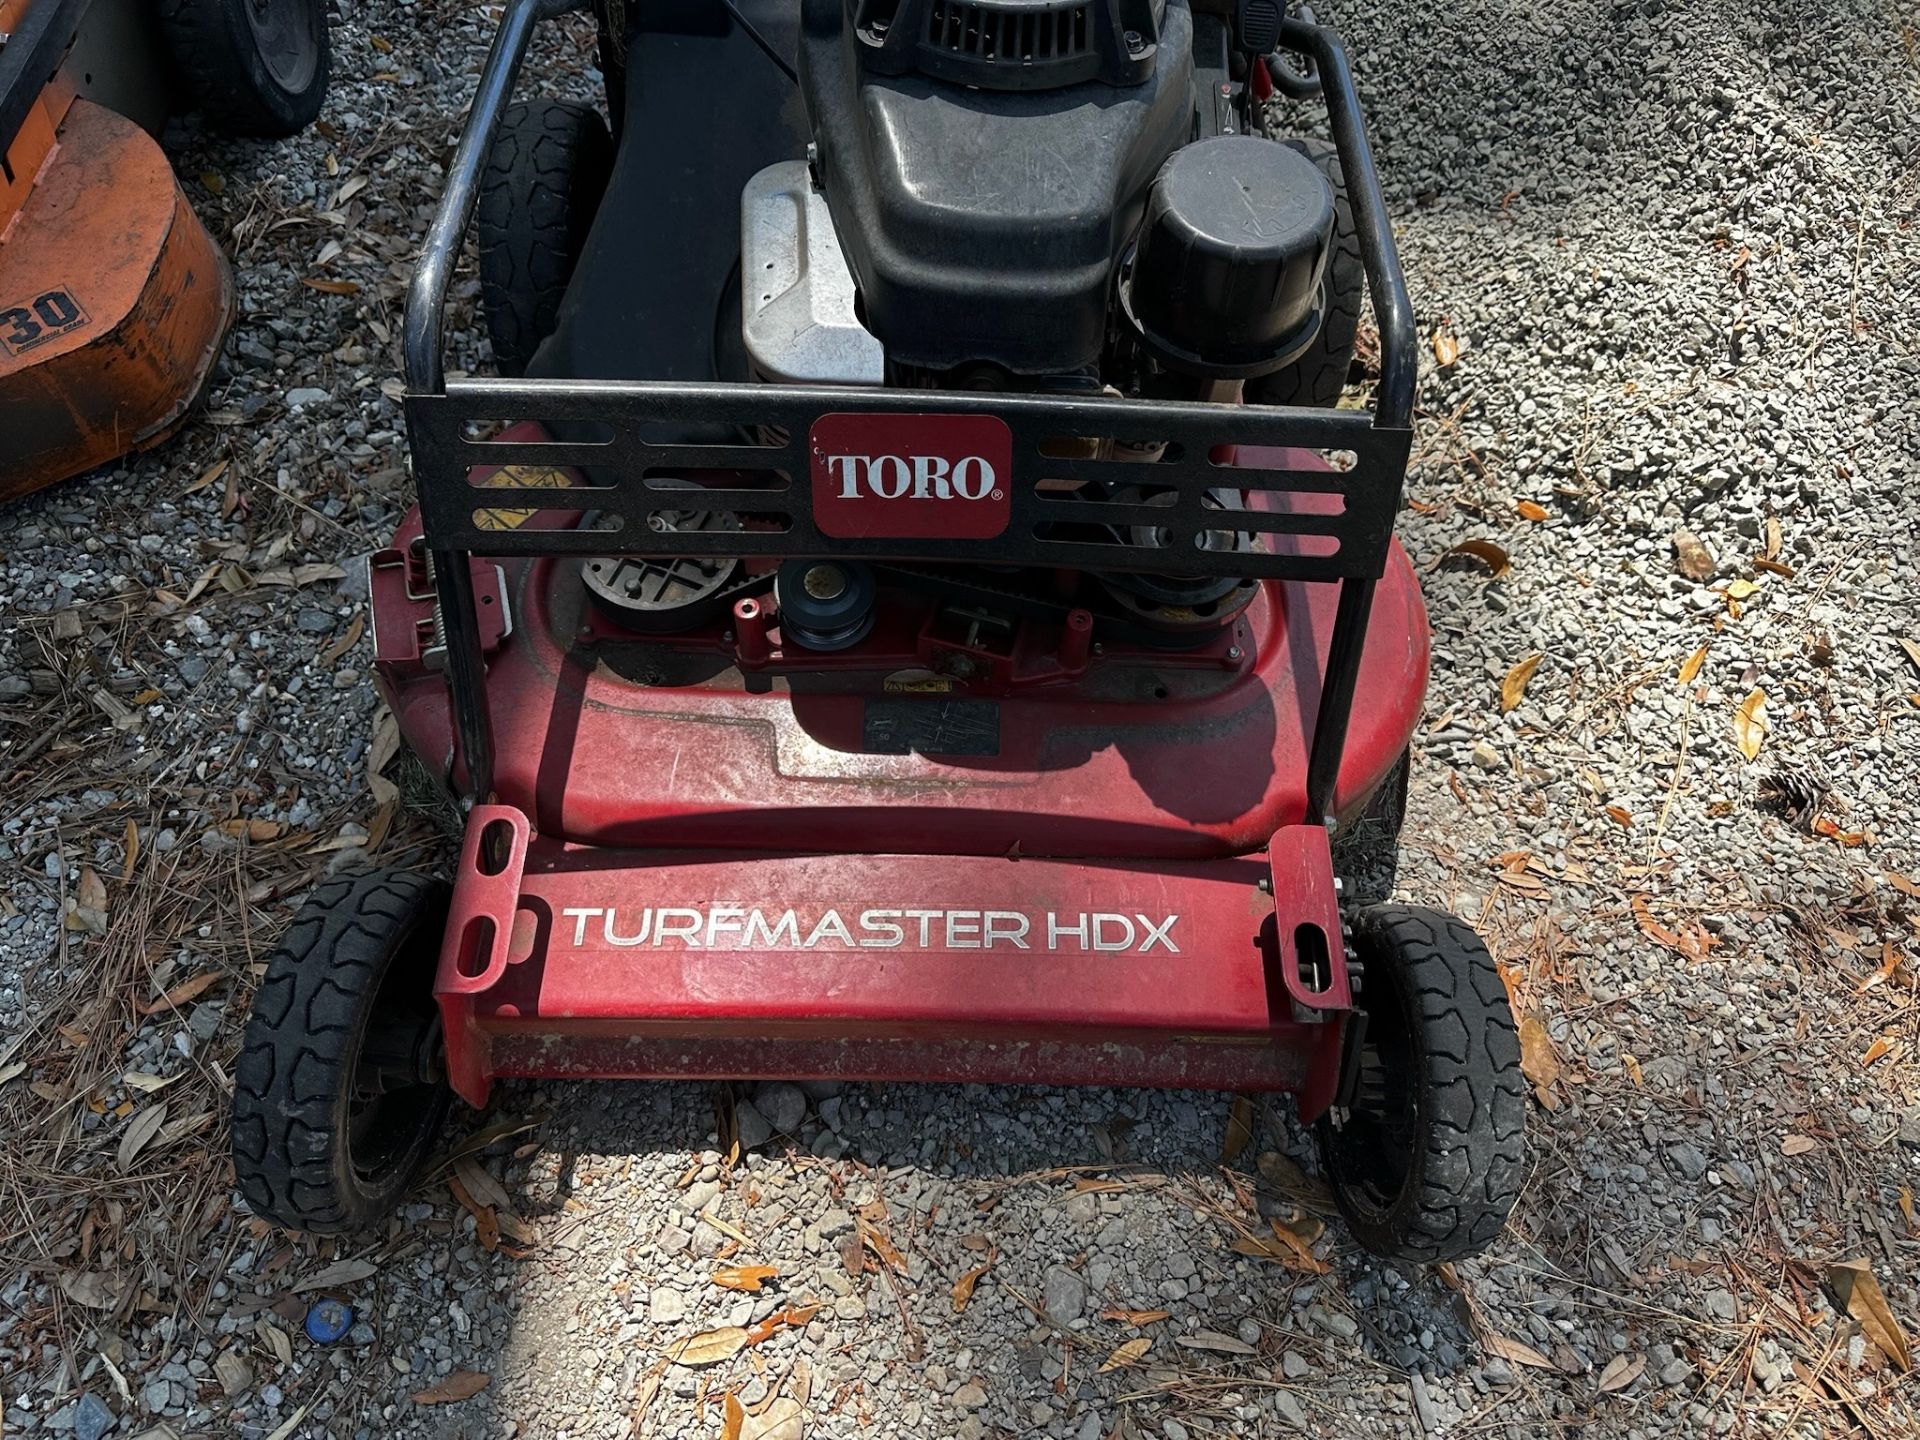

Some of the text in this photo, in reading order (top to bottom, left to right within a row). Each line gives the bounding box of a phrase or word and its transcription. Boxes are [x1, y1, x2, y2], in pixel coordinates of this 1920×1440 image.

[0, 291, 80, 344] 30
[562, 907, 1181, 953] TURFMASTER HDX
